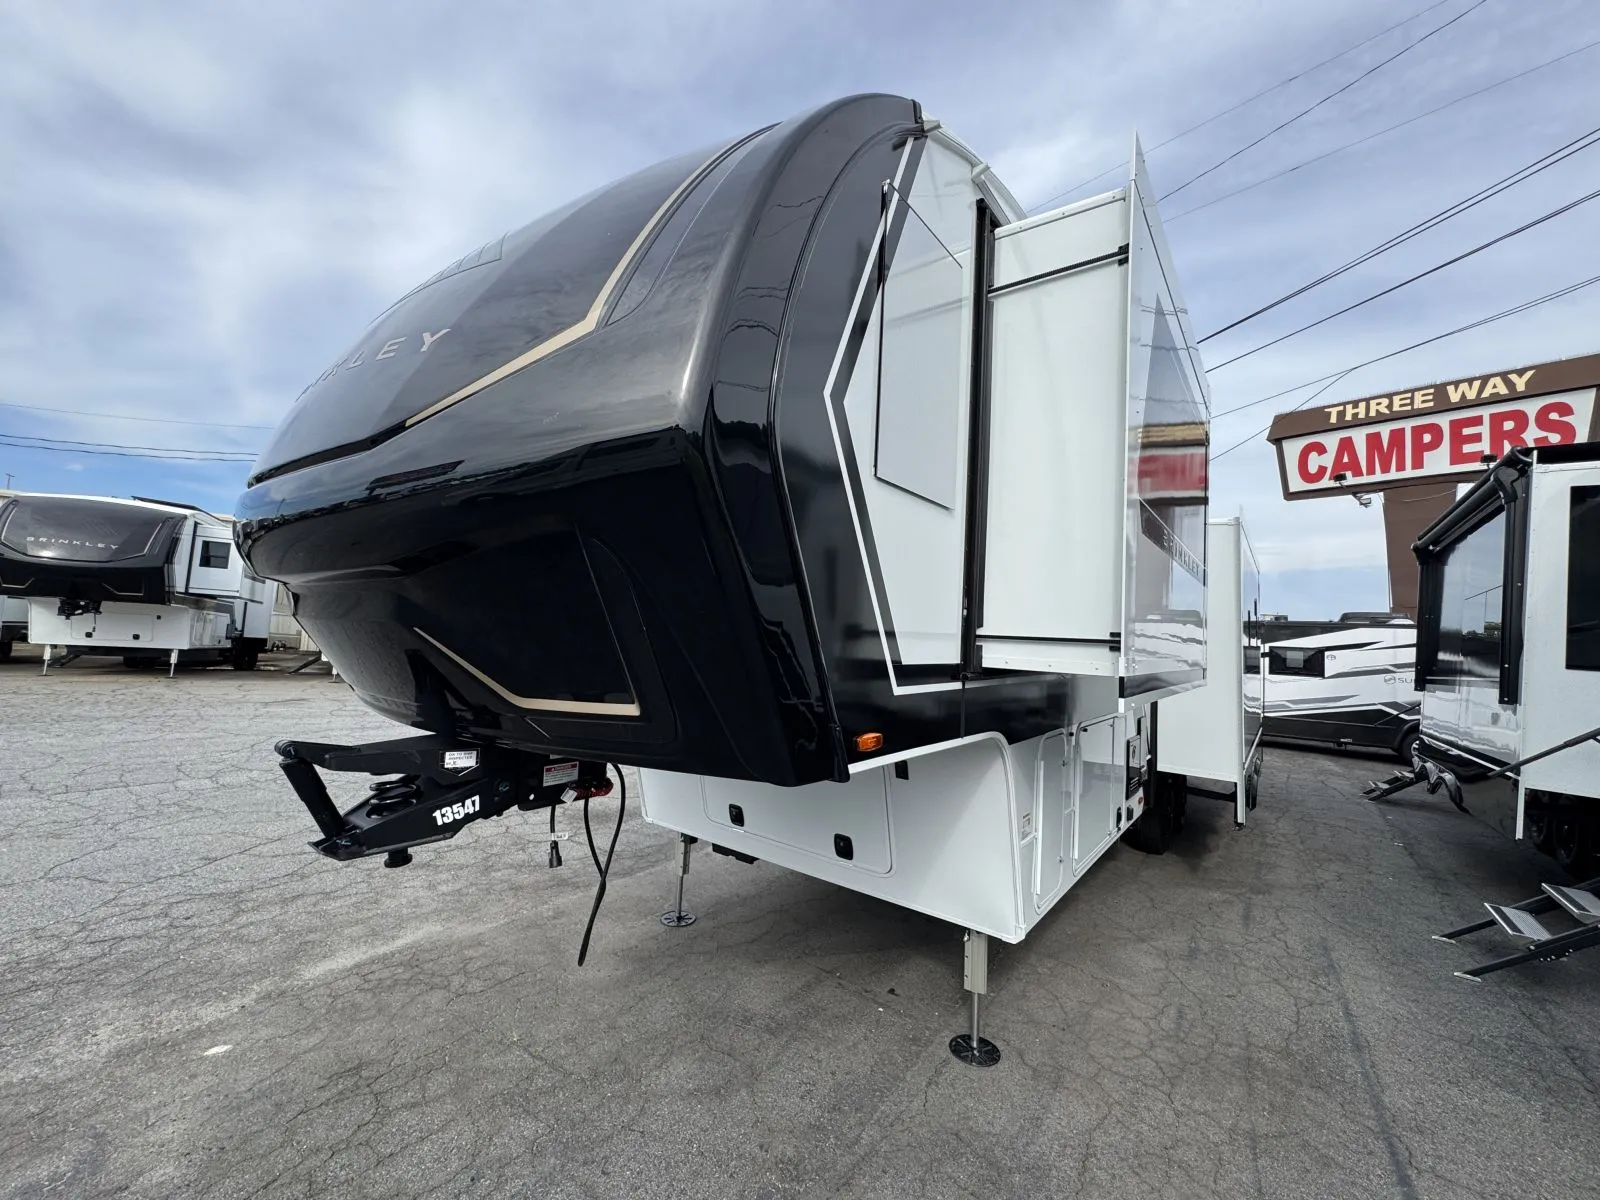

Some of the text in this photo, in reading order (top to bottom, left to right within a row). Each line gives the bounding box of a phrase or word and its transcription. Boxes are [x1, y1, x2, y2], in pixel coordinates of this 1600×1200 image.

[1325, 369, 1536, 424] THREE WAY
[1297, 401, 1577, 484] CAMPERS
[26, 536, 119, 550] BRINKLEY
[432, 794, 480, 826] 13547
